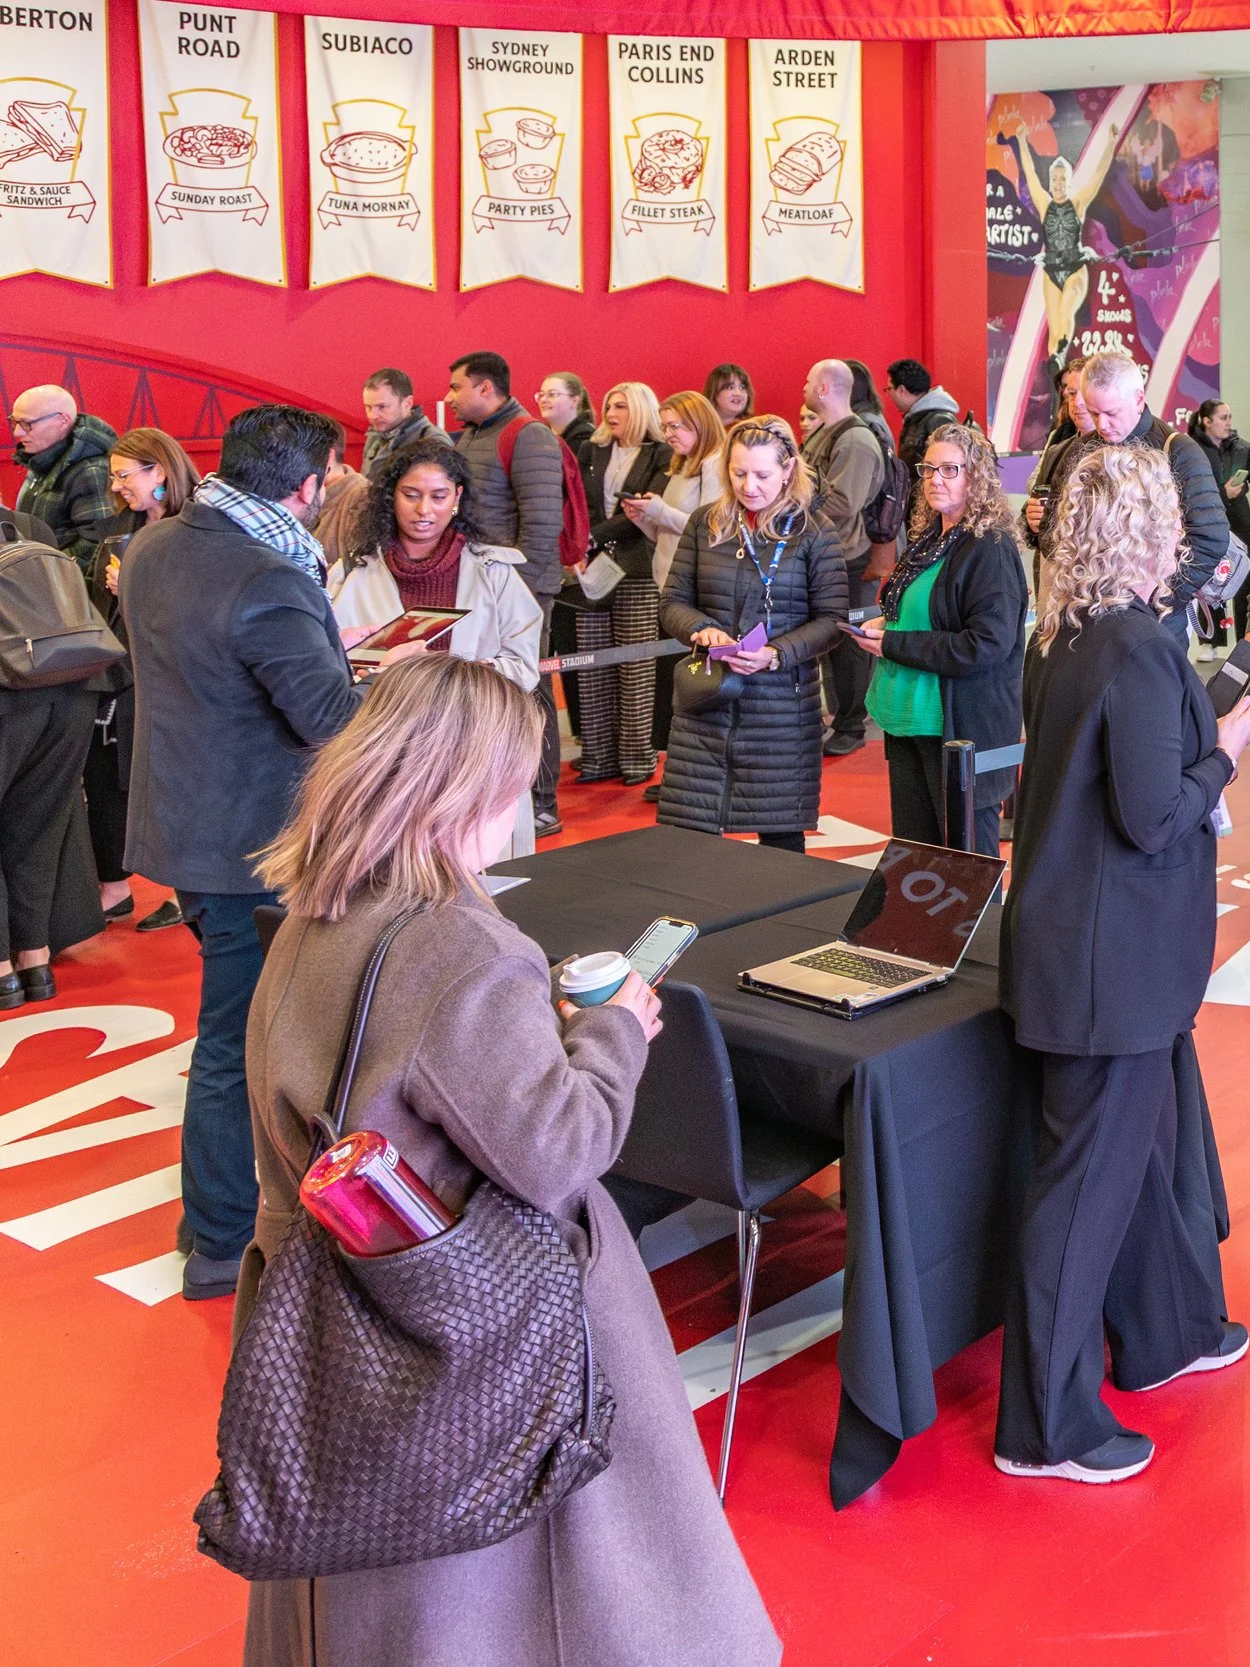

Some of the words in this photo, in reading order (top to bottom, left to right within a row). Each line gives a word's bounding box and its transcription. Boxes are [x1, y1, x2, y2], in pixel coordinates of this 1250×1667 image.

[0, 6, 92, 31] BERTON
[179, 11, 237, 34] PUNT
[178, 36, 240, 58] ROAD
[322, 33, 413, 55] SUBIACO
[492, 41, 549, 57] SYDNEY
[619, 42, 672, 61] PARIS
[680, 45, 714, 62] END
[467, 57, 574, 75] SHOWGROUND
[774, 49, 835, 66] ARDEN
[628, 66, 704, 84] COLLINS
[773, 71, 837, 88] STREET
[29, 187, 38, 195] &
[39, 186, 71, 196] SAUCE
[171, 191, 214, 206] SUNDAY
[219, 193, 253, 206] ROAST
[7, 195, 63, 206] SANDWICH
[327, 198, 359, 211] TUNA
[361, 200, 411, 212] MORNAY
[488, 203, 526, 216] PARTY
[530, 204, 555, 216] PIES
[631, 205, 665, 218] FILLET
[669, 205, 705, 219] STEAK
[779, 208, 835, 220] MEATLOAF
[986, 204, 1014, 221] ALE
[1097, 270, 1116, 305] 4
[561, 654, 594, 668] STADIUM
